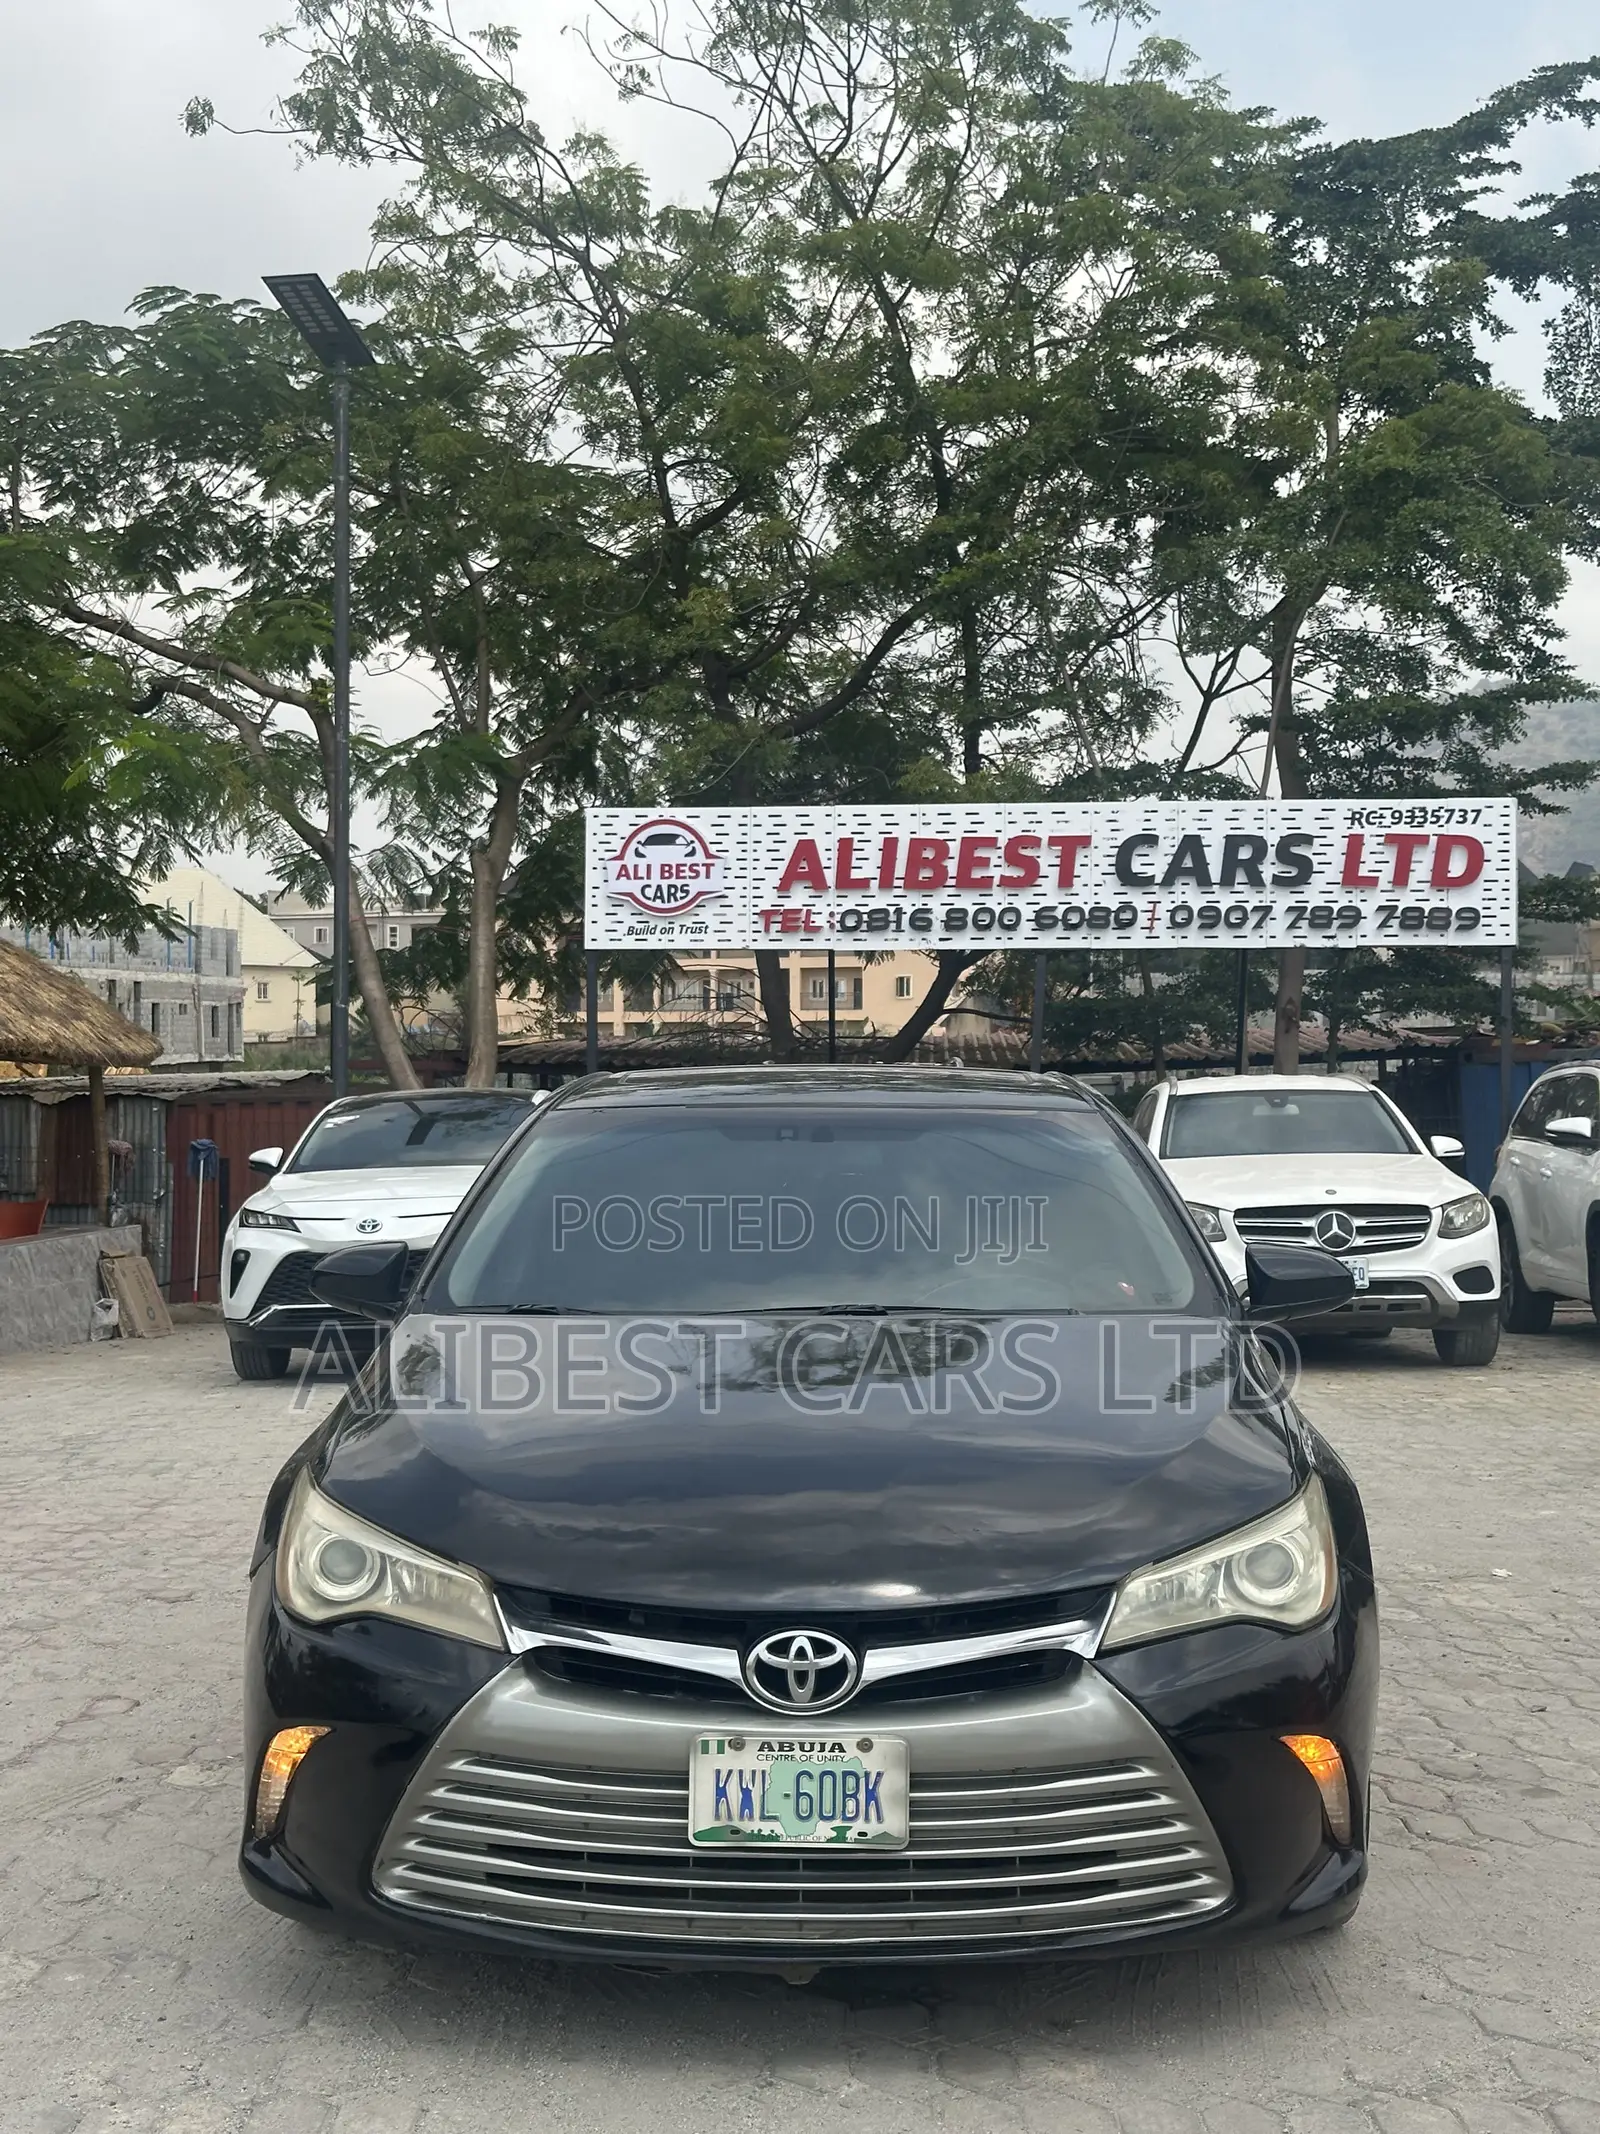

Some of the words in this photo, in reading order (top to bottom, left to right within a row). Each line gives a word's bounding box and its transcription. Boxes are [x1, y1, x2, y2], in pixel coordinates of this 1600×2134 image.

[1390, 808, 1483, 826] 9335737
[776, 834, 1092, 892] ALIBEST
[1114, 832, 1315, 889] CARS
[1341, 832, 1485, 889] LTD
[615, 863, 652, 881] ALI
[660, 862, 716, 880] BEST
[640, 883, 691, 904] CARS
[839, 906, 934, 932] 0816
[944, 906, 1022, 931] 800
[1034, 904, 1139, 930] 6080
[1168, 903, 1274, 931] 0907
[1284, 904, 1362, 931] 789
[1375, 904, 1482, 932] 7889
[659, 926, 675, 936] on
[679, 924, 710, 936] Trust
[756, 1741, 847, 1754] ABUJA
[756, 1753, 798, 1762] CENTRE
[799, 1754, 815, 1763] OF
[816, 1754, 847, 1763] UNITY
